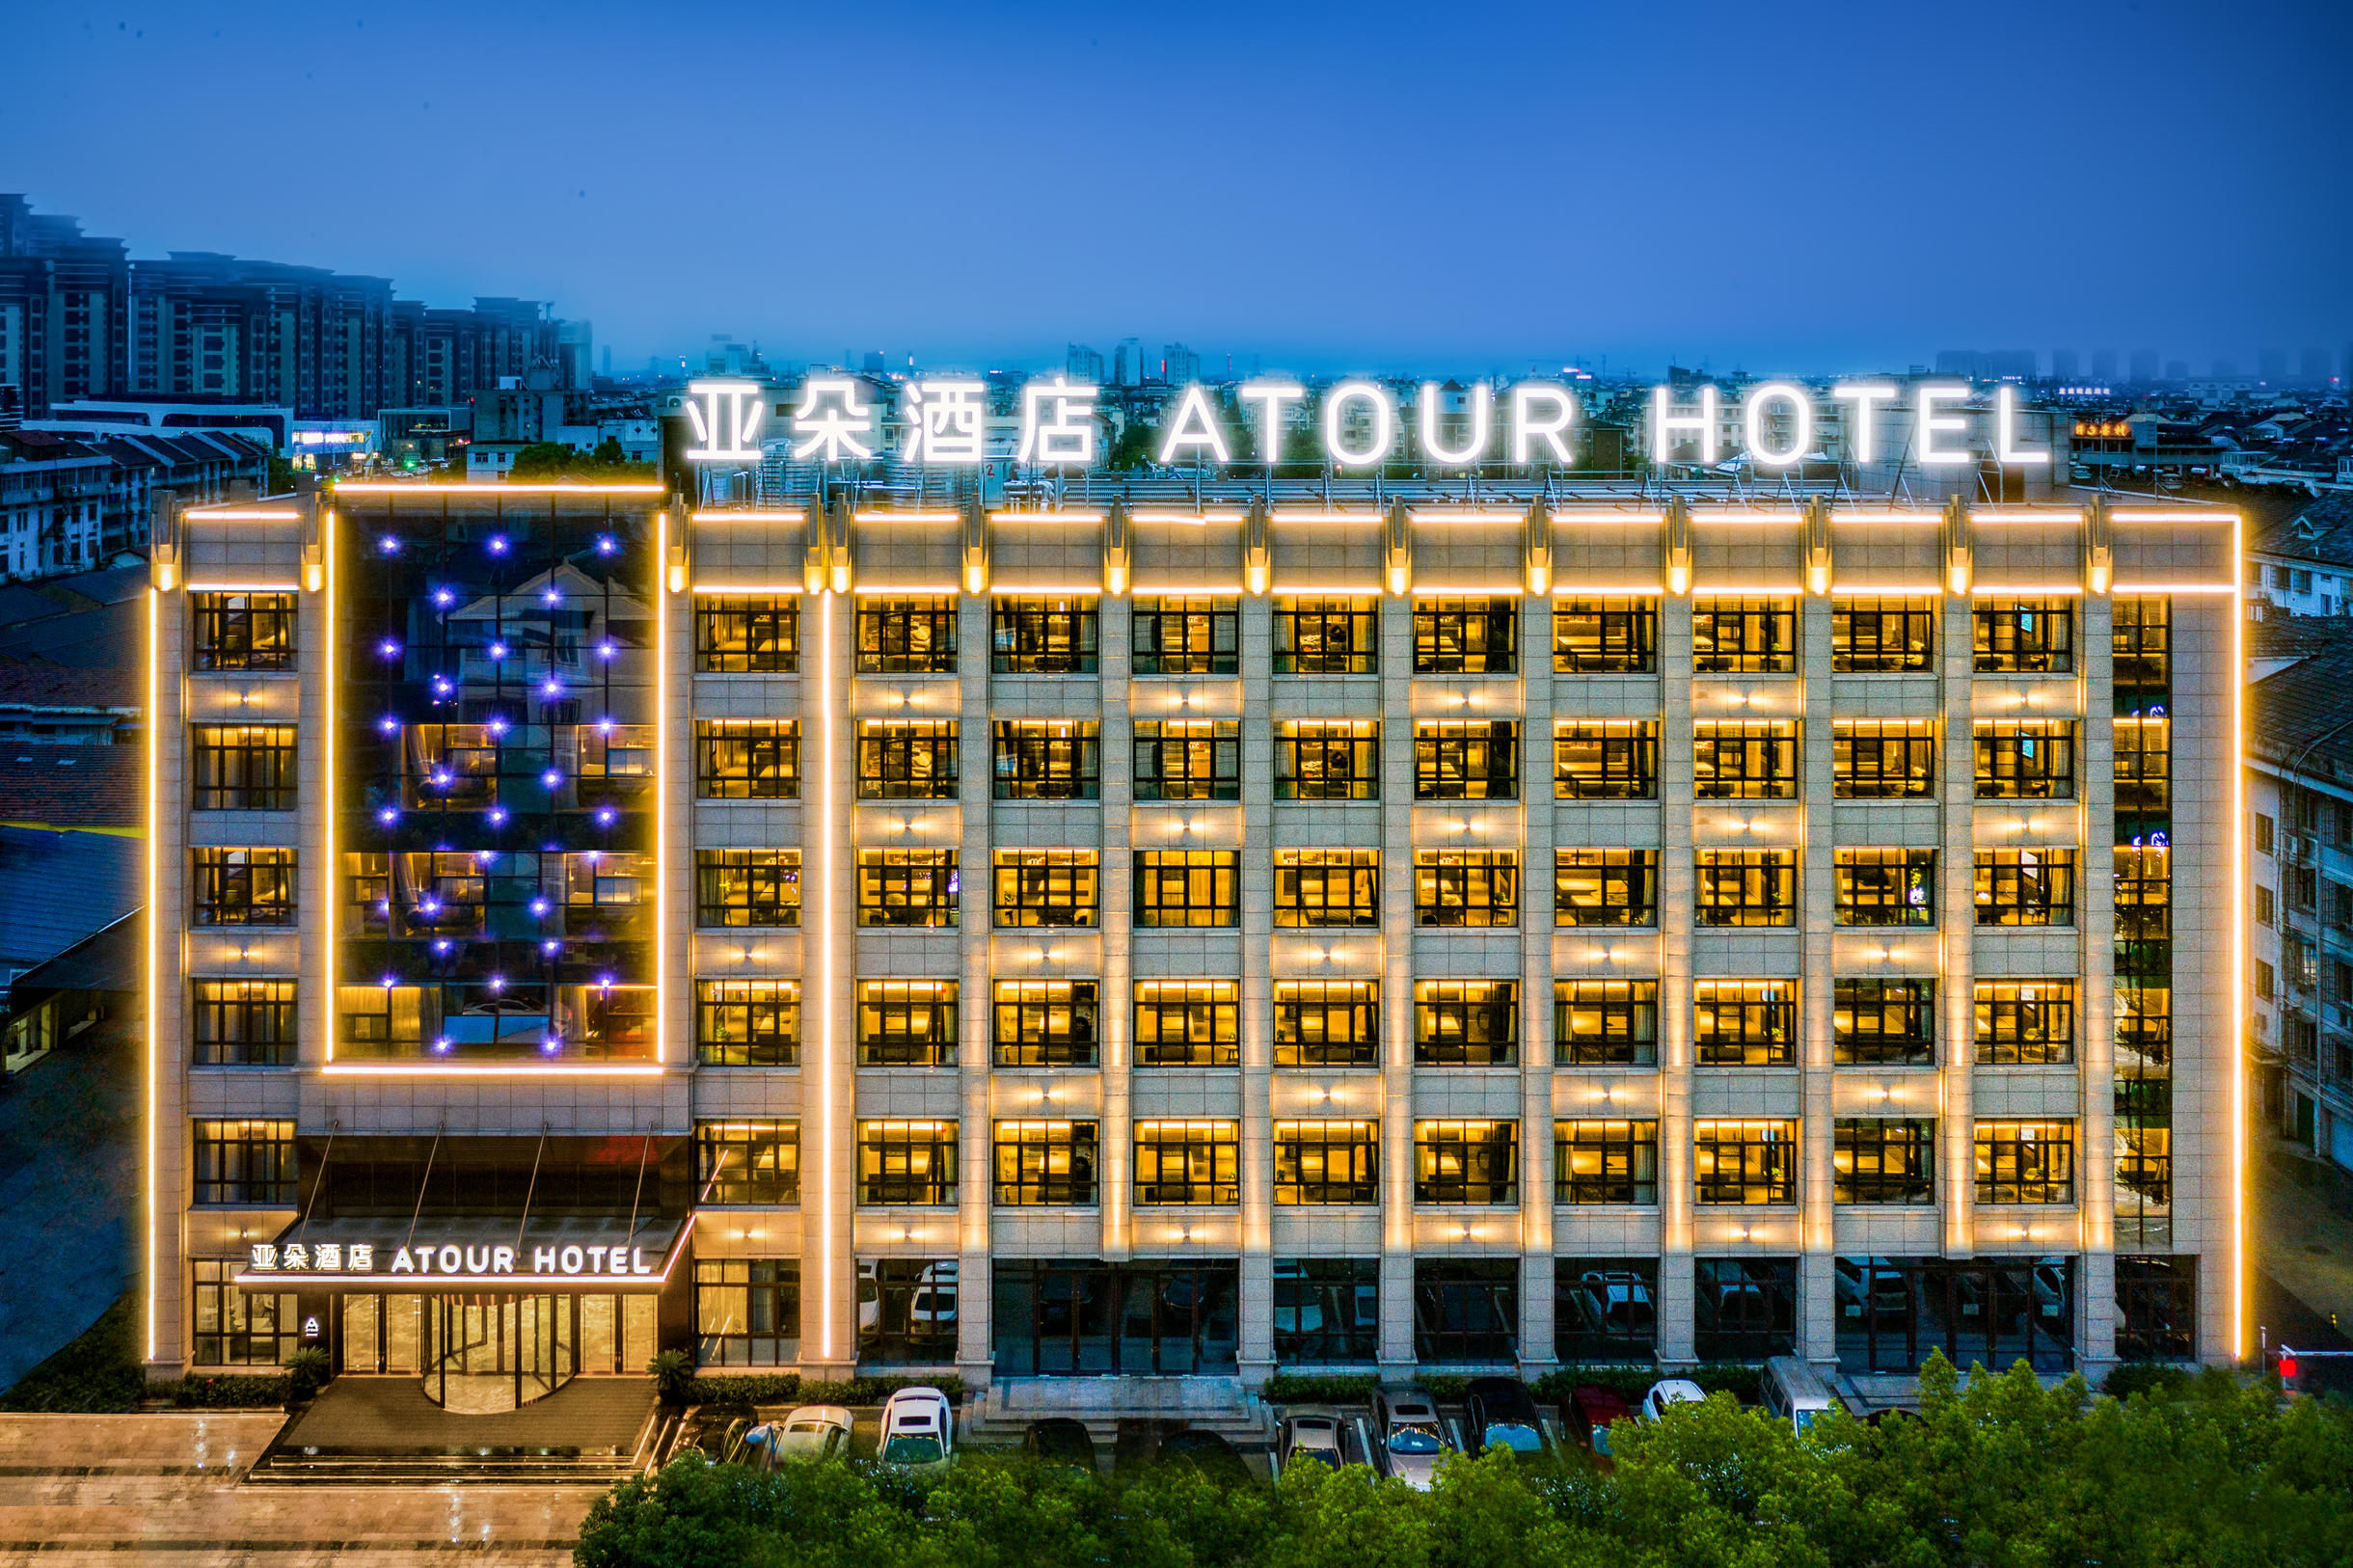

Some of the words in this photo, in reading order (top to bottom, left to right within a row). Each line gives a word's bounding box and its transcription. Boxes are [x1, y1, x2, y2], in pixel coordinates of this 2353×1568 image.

[685, 376, 1099, 464] 亚朵酒店
[1159, 383, 1575, 466] ATOUR
[1653, 383, 2049, 466] HOTEL
[252, 1243, 373, 1271] 亚朵酒店
[391, 1245, 514, 1274] ATOUR
[534, 1246, 651, 1274] HOTEL
